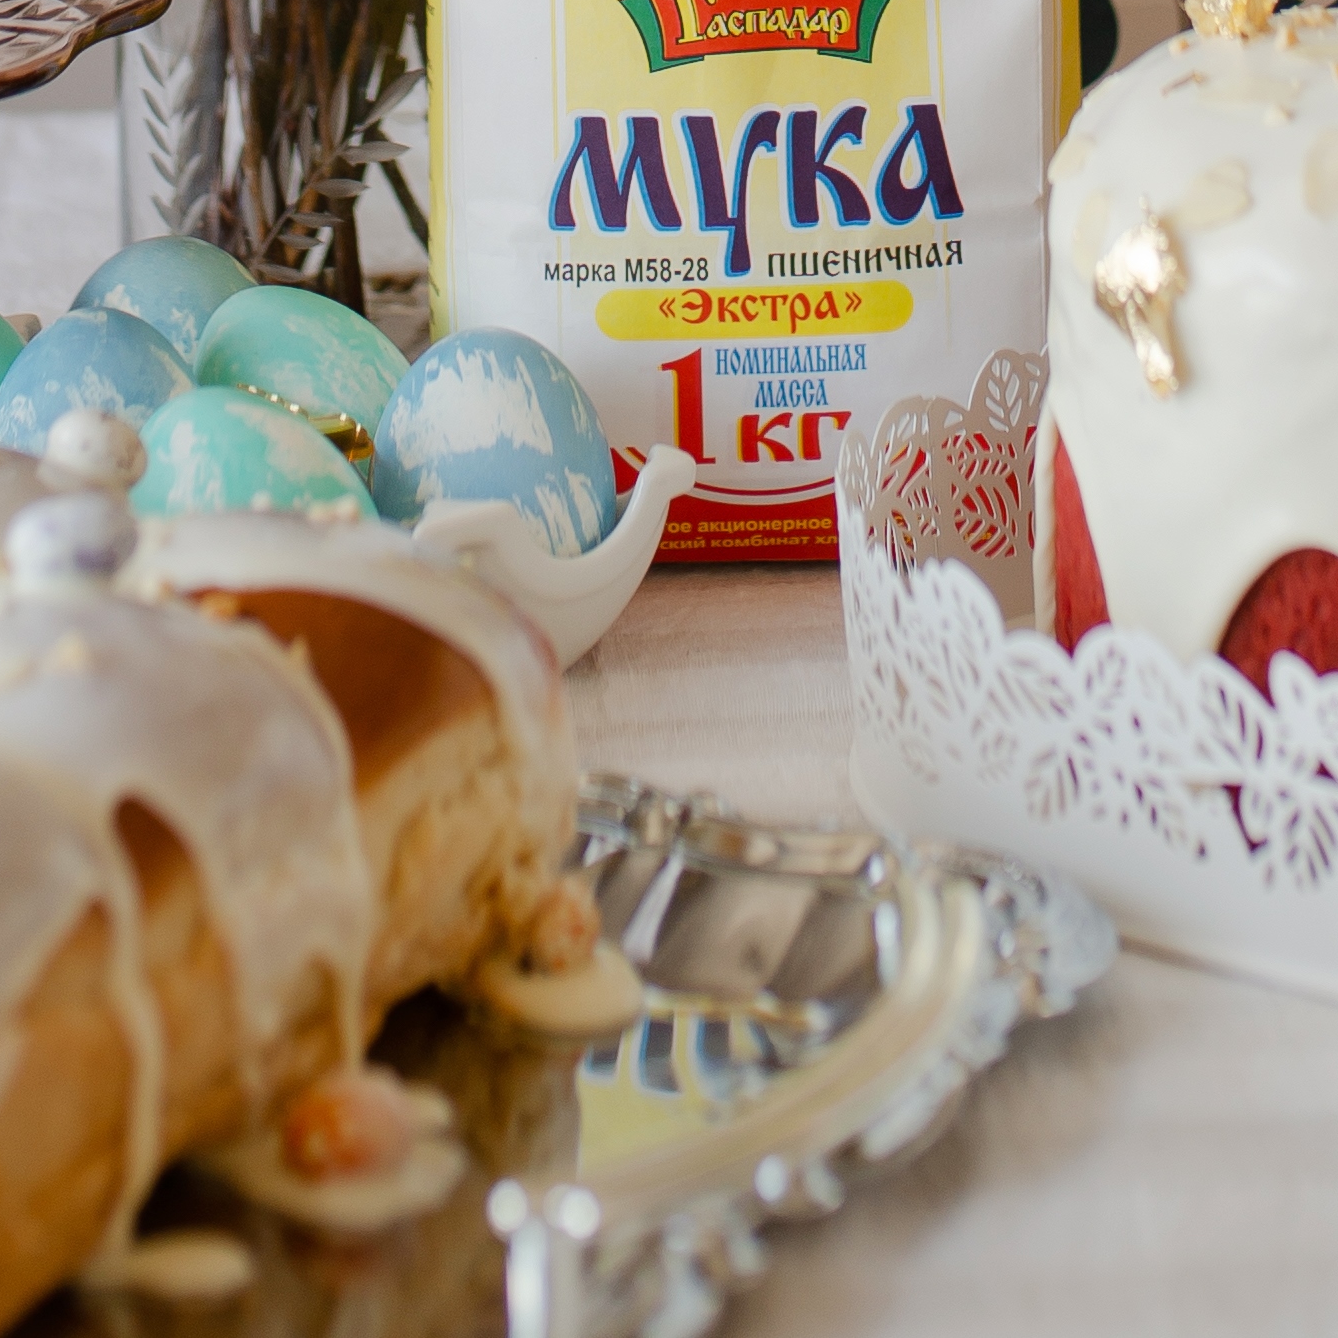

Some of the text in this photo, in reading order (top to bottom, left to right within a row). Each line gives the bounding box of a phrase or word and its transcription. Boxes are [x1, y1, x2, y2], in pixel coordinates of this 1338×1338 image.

[547, 102, 965, 278] МУКА
[544, 257, 709, 288] марка М58-28
[658, 288, 863, 334] «Экстра»
[715, 344, 868, 376] НОМИНАЛЬНАЯ
[657, 347, 853, 466] 1 кг
[754, 378, 829, 408] МАССА
[698, 517, 832, 534] акционерное
[660, 536, 706, 550] ский
[710, 534, 810, 549] комбинат
